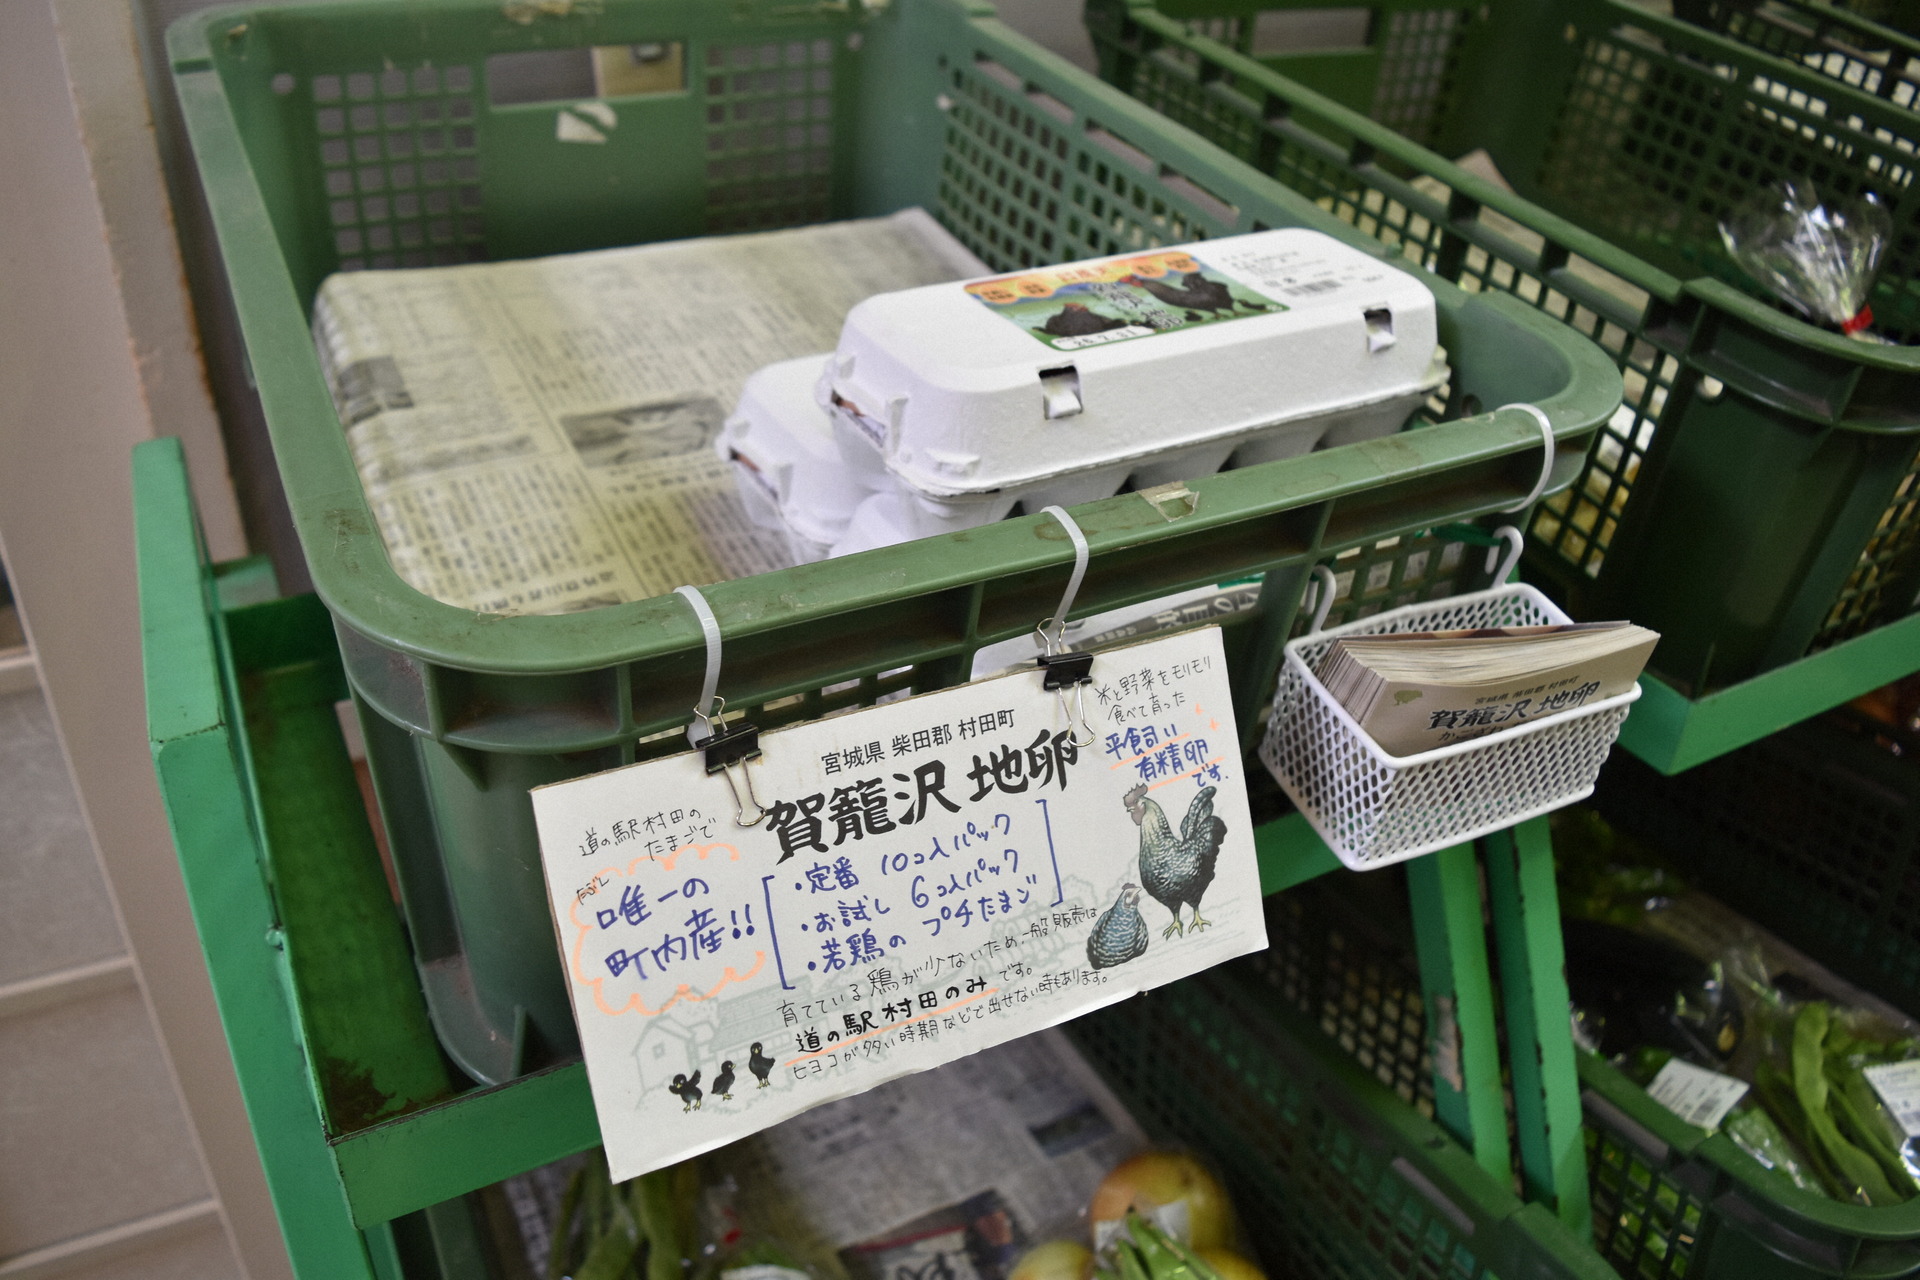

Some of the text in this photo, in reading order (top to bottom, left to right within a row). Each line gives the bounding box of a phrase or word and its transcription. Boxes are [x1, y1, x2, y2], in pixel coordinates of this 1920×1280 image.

[1096, 654, 1212, 705] 米と野菜をモリモリ
[1533, 680, 1601, 714] 地卵
[1107, 690, 1186, 726] 食べて育った
[821, 708, 1016, 776] 宮城県 柴田郡 村田町
[1104, 723, 1179, 761] 平飼い
[1134, 738, 1209, 783] 有精卵
[766, 728, 1079, 866] 賀籠沢 地卵
[579, 807, 702, 857] 道の駅村田の
[643, 817, 717, 862] たまごで
[596, 877, 710, 930] 唯一の
